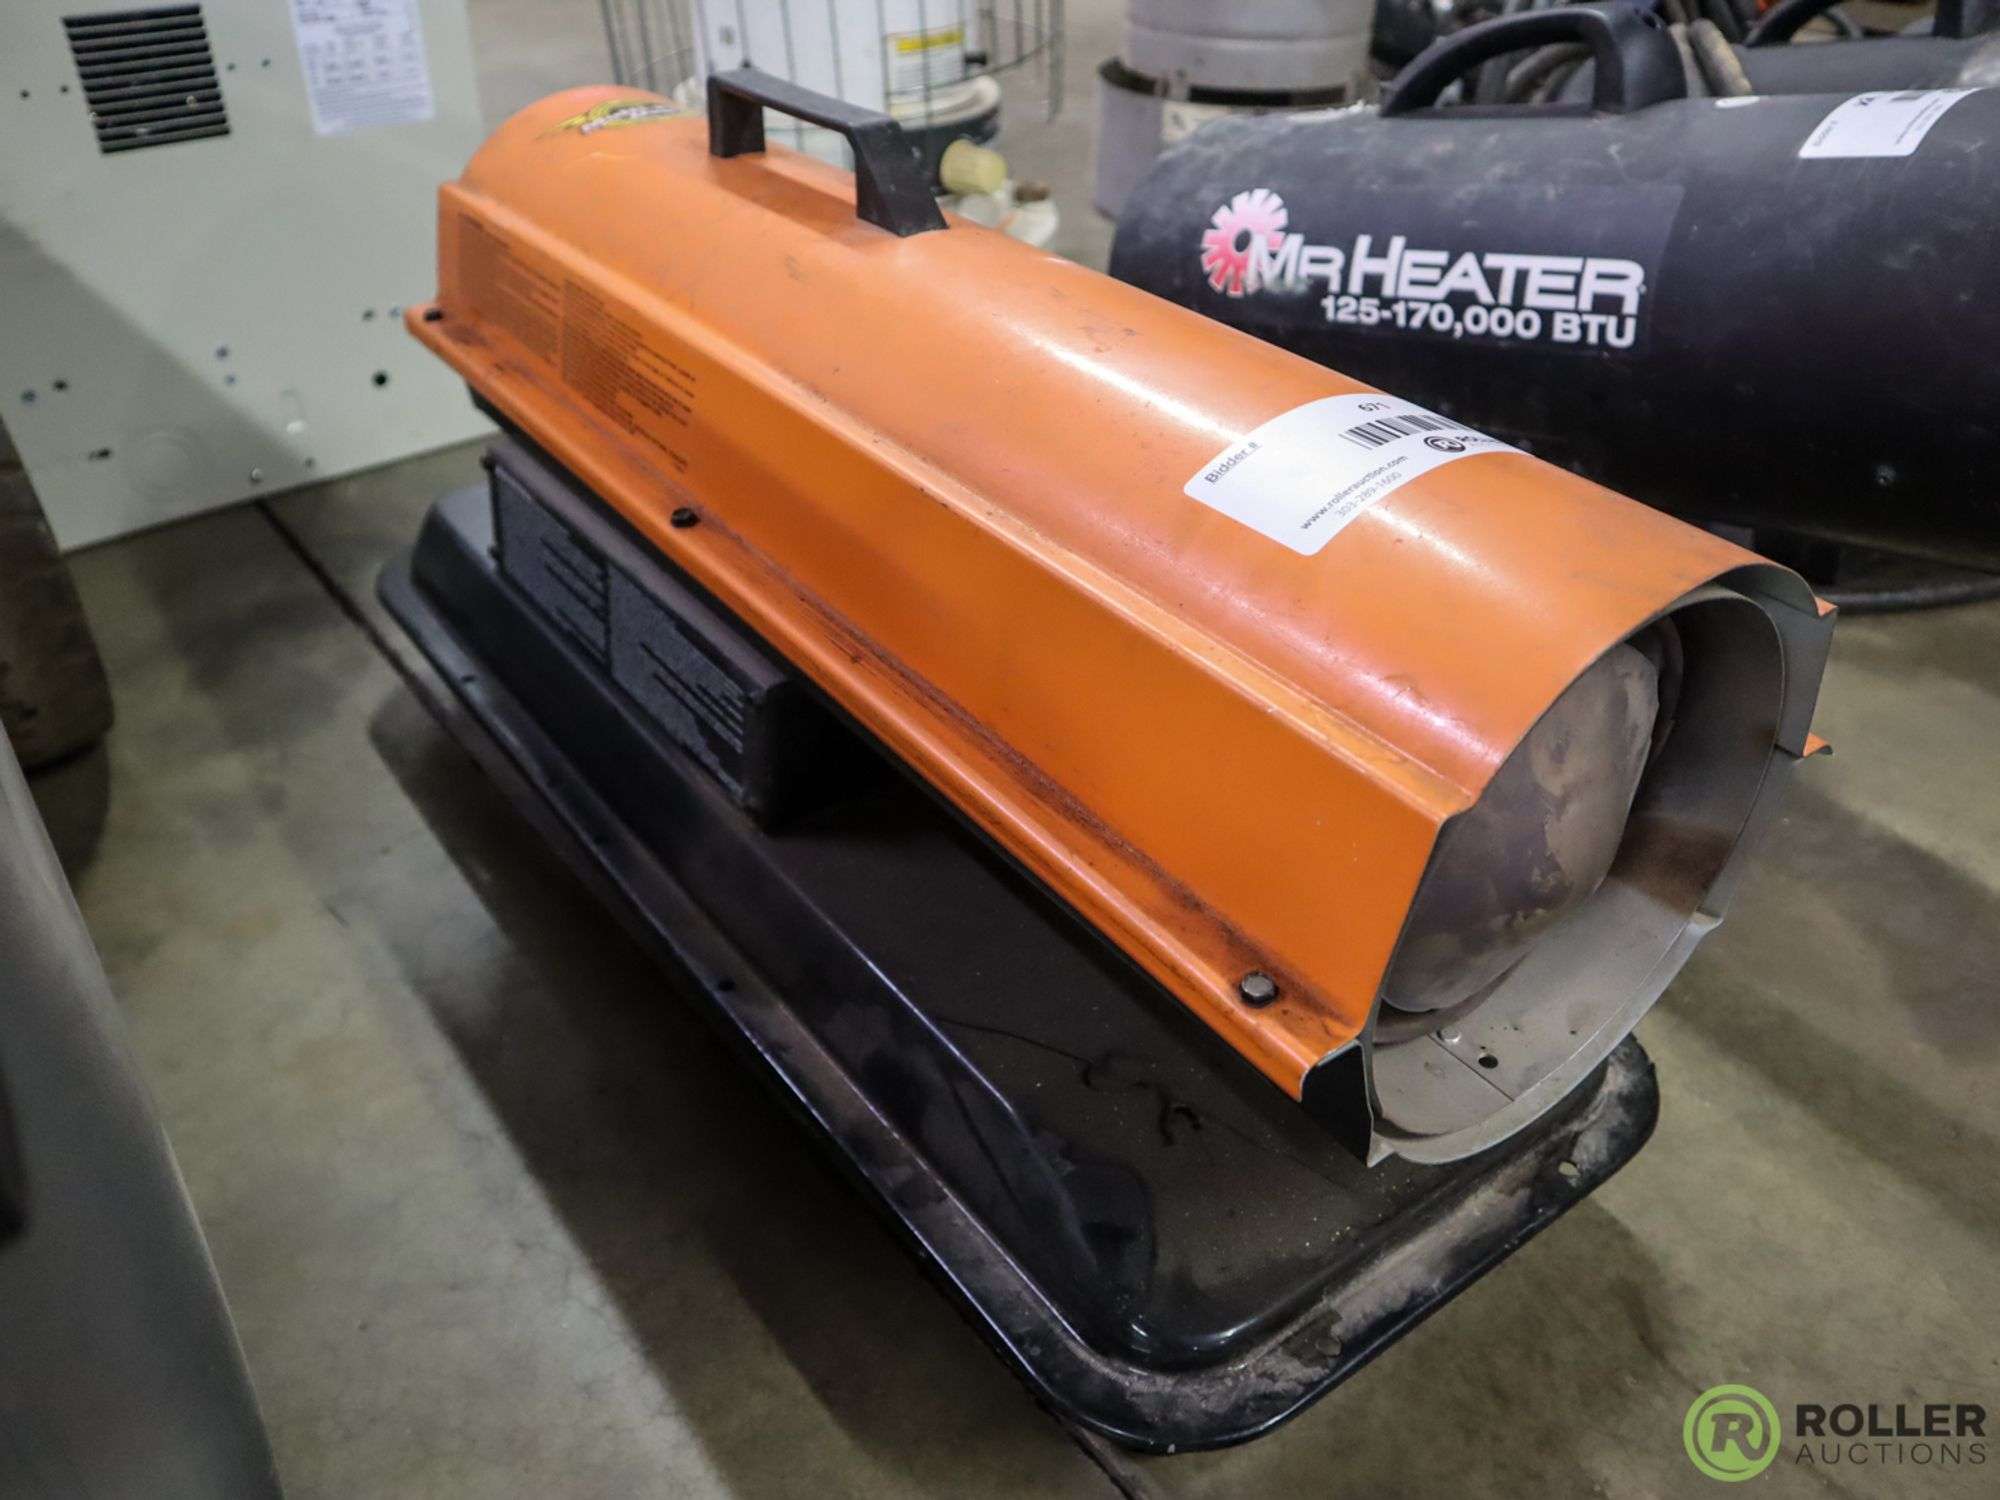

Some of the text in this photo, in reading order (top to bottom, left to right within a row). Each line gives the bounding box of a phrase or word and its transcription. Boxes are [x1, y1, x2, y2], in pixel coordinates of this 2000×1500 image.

[1347, 233, 1645, 315] HEATER
[1321, 294, 1637, 349] 125-170,000 BTU
[1204, 448, 1249, 483] Bidder
[1300, 455, 1407, 530] www.rollerauction.com
